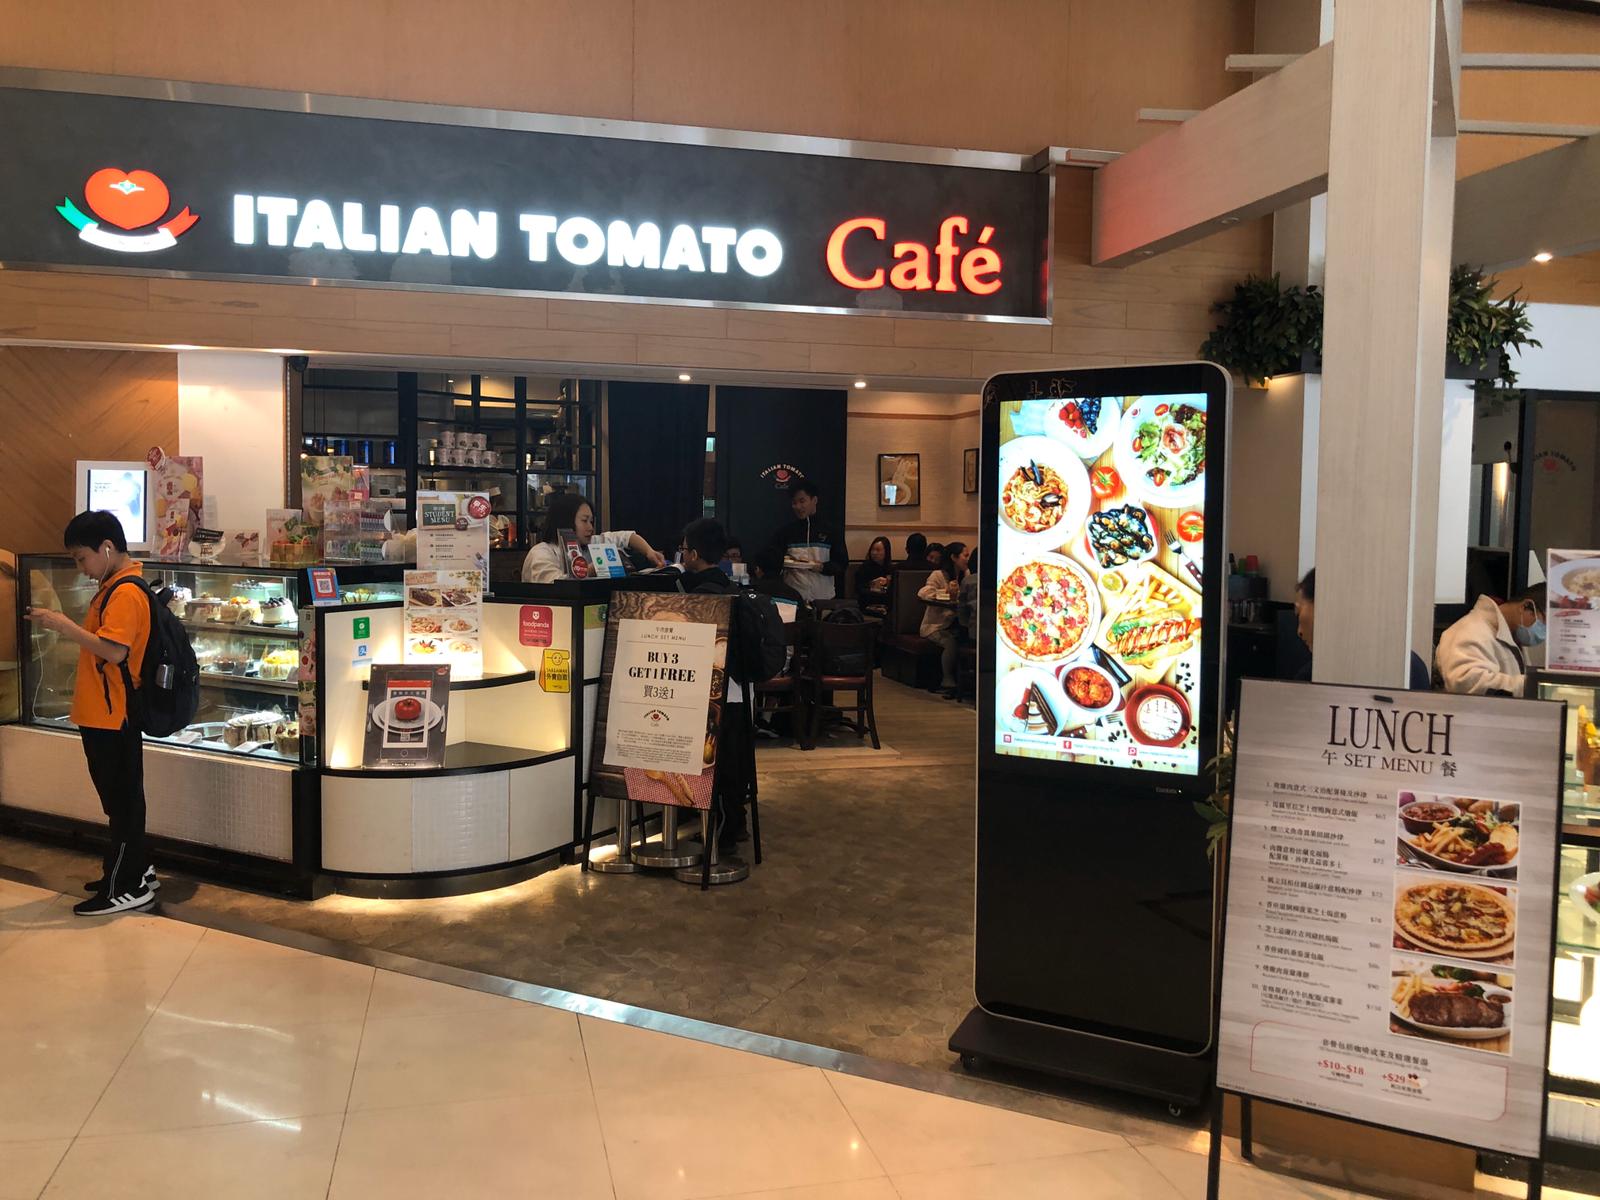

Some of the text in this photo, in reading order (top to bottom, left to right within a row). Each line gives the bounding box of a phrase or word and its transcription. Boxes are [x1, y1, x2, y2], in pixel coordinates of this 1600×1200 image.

[232, 193, 1003, 295] ITALIAN TOMATO Café
[759, 464, 781, 479] ITALIAN
[423, 510, 455, 519] STUDENT
[522, 620, 550, 629] foodpanda
[647, 651, 679, 665] BUY 3
[628, 665, 696, 683] GET 1 FREE
[643, 684, 674, 700] 買3送1
[1326, 704, 1455, 757] LUNCH
[1321, 748, 1458, 778] 午 SET MENU 餐
[1381, 1072, 1406, 1084] +$29
